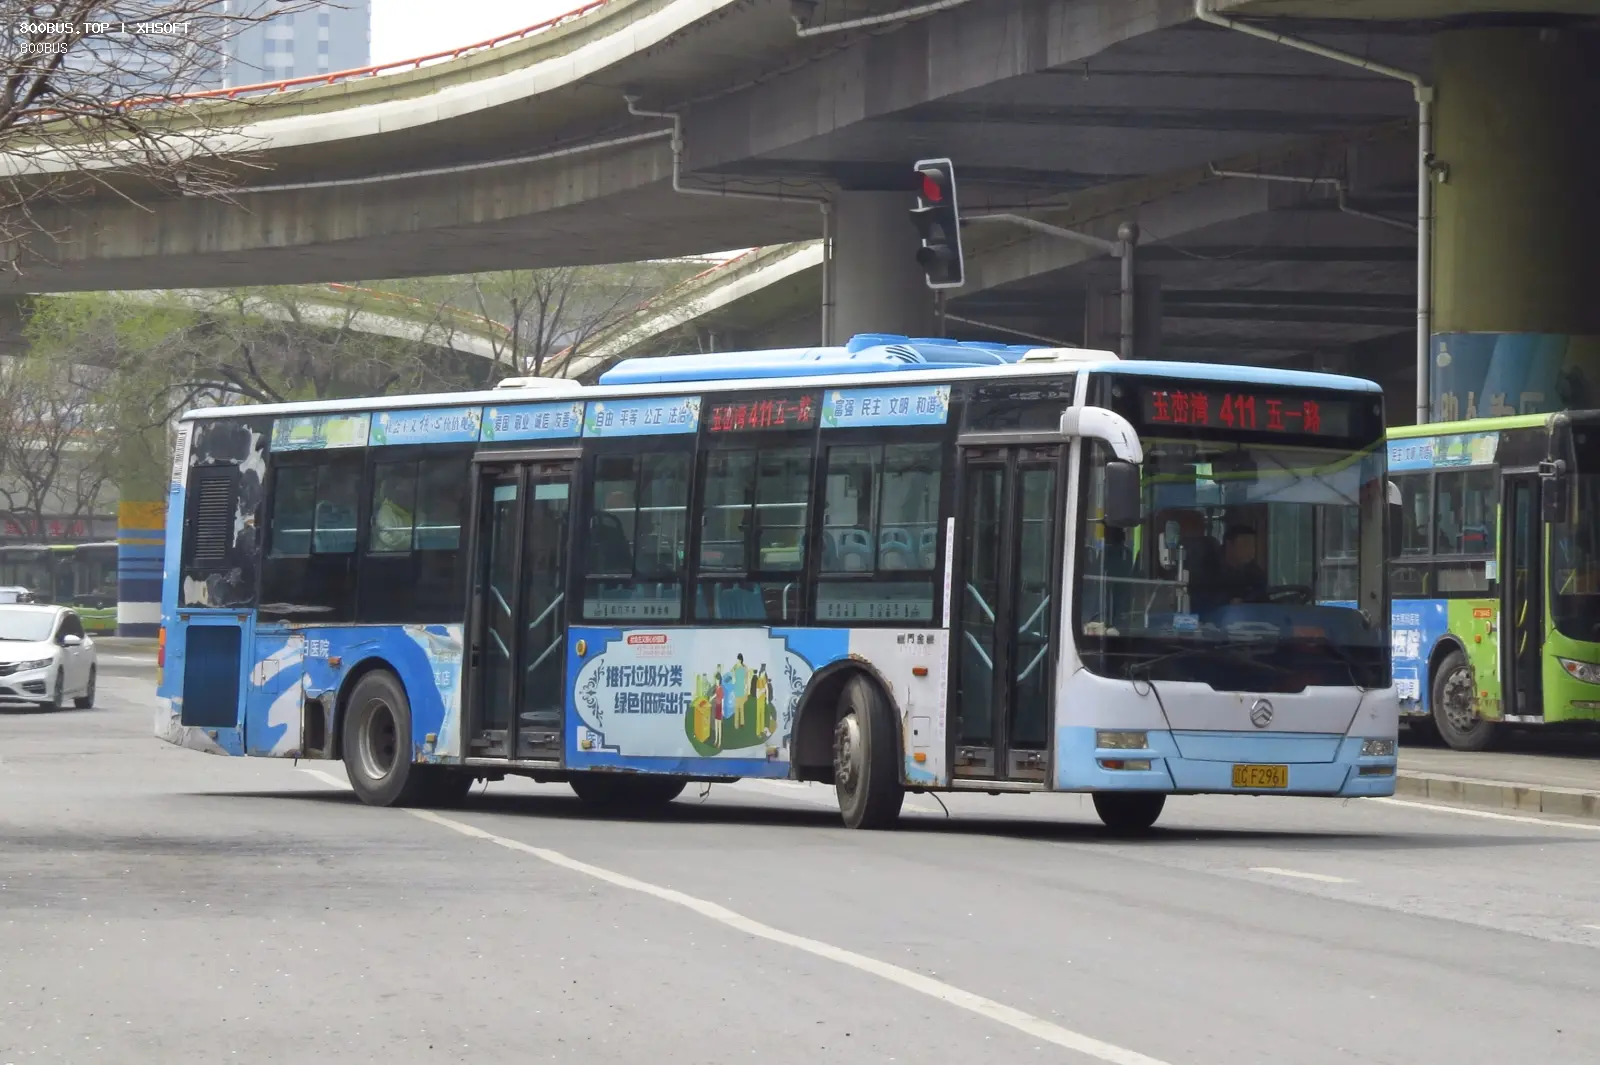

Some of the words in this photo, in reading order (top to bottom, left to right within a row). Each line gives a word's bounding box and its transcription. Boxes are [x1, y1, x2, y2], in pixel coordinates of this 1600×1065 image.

[596, 410, 614, 428] 自由
[620, 408, 639, 426] 平等
[644, 407, 663, 425] 公正
[668, 406, 687, 424] 法治
[834, 399, 854, 417] 富强
[861, 398, 882, 416] 民主
[888, 397, 910, 415] 文明
[916, 395, 938, 414] 和谐
[1219, 394, 1257, 429] 411
[606, 665, 683, 688] 推行垃圾分类
[614, 692, 692, 715] 绿色低碳出行
